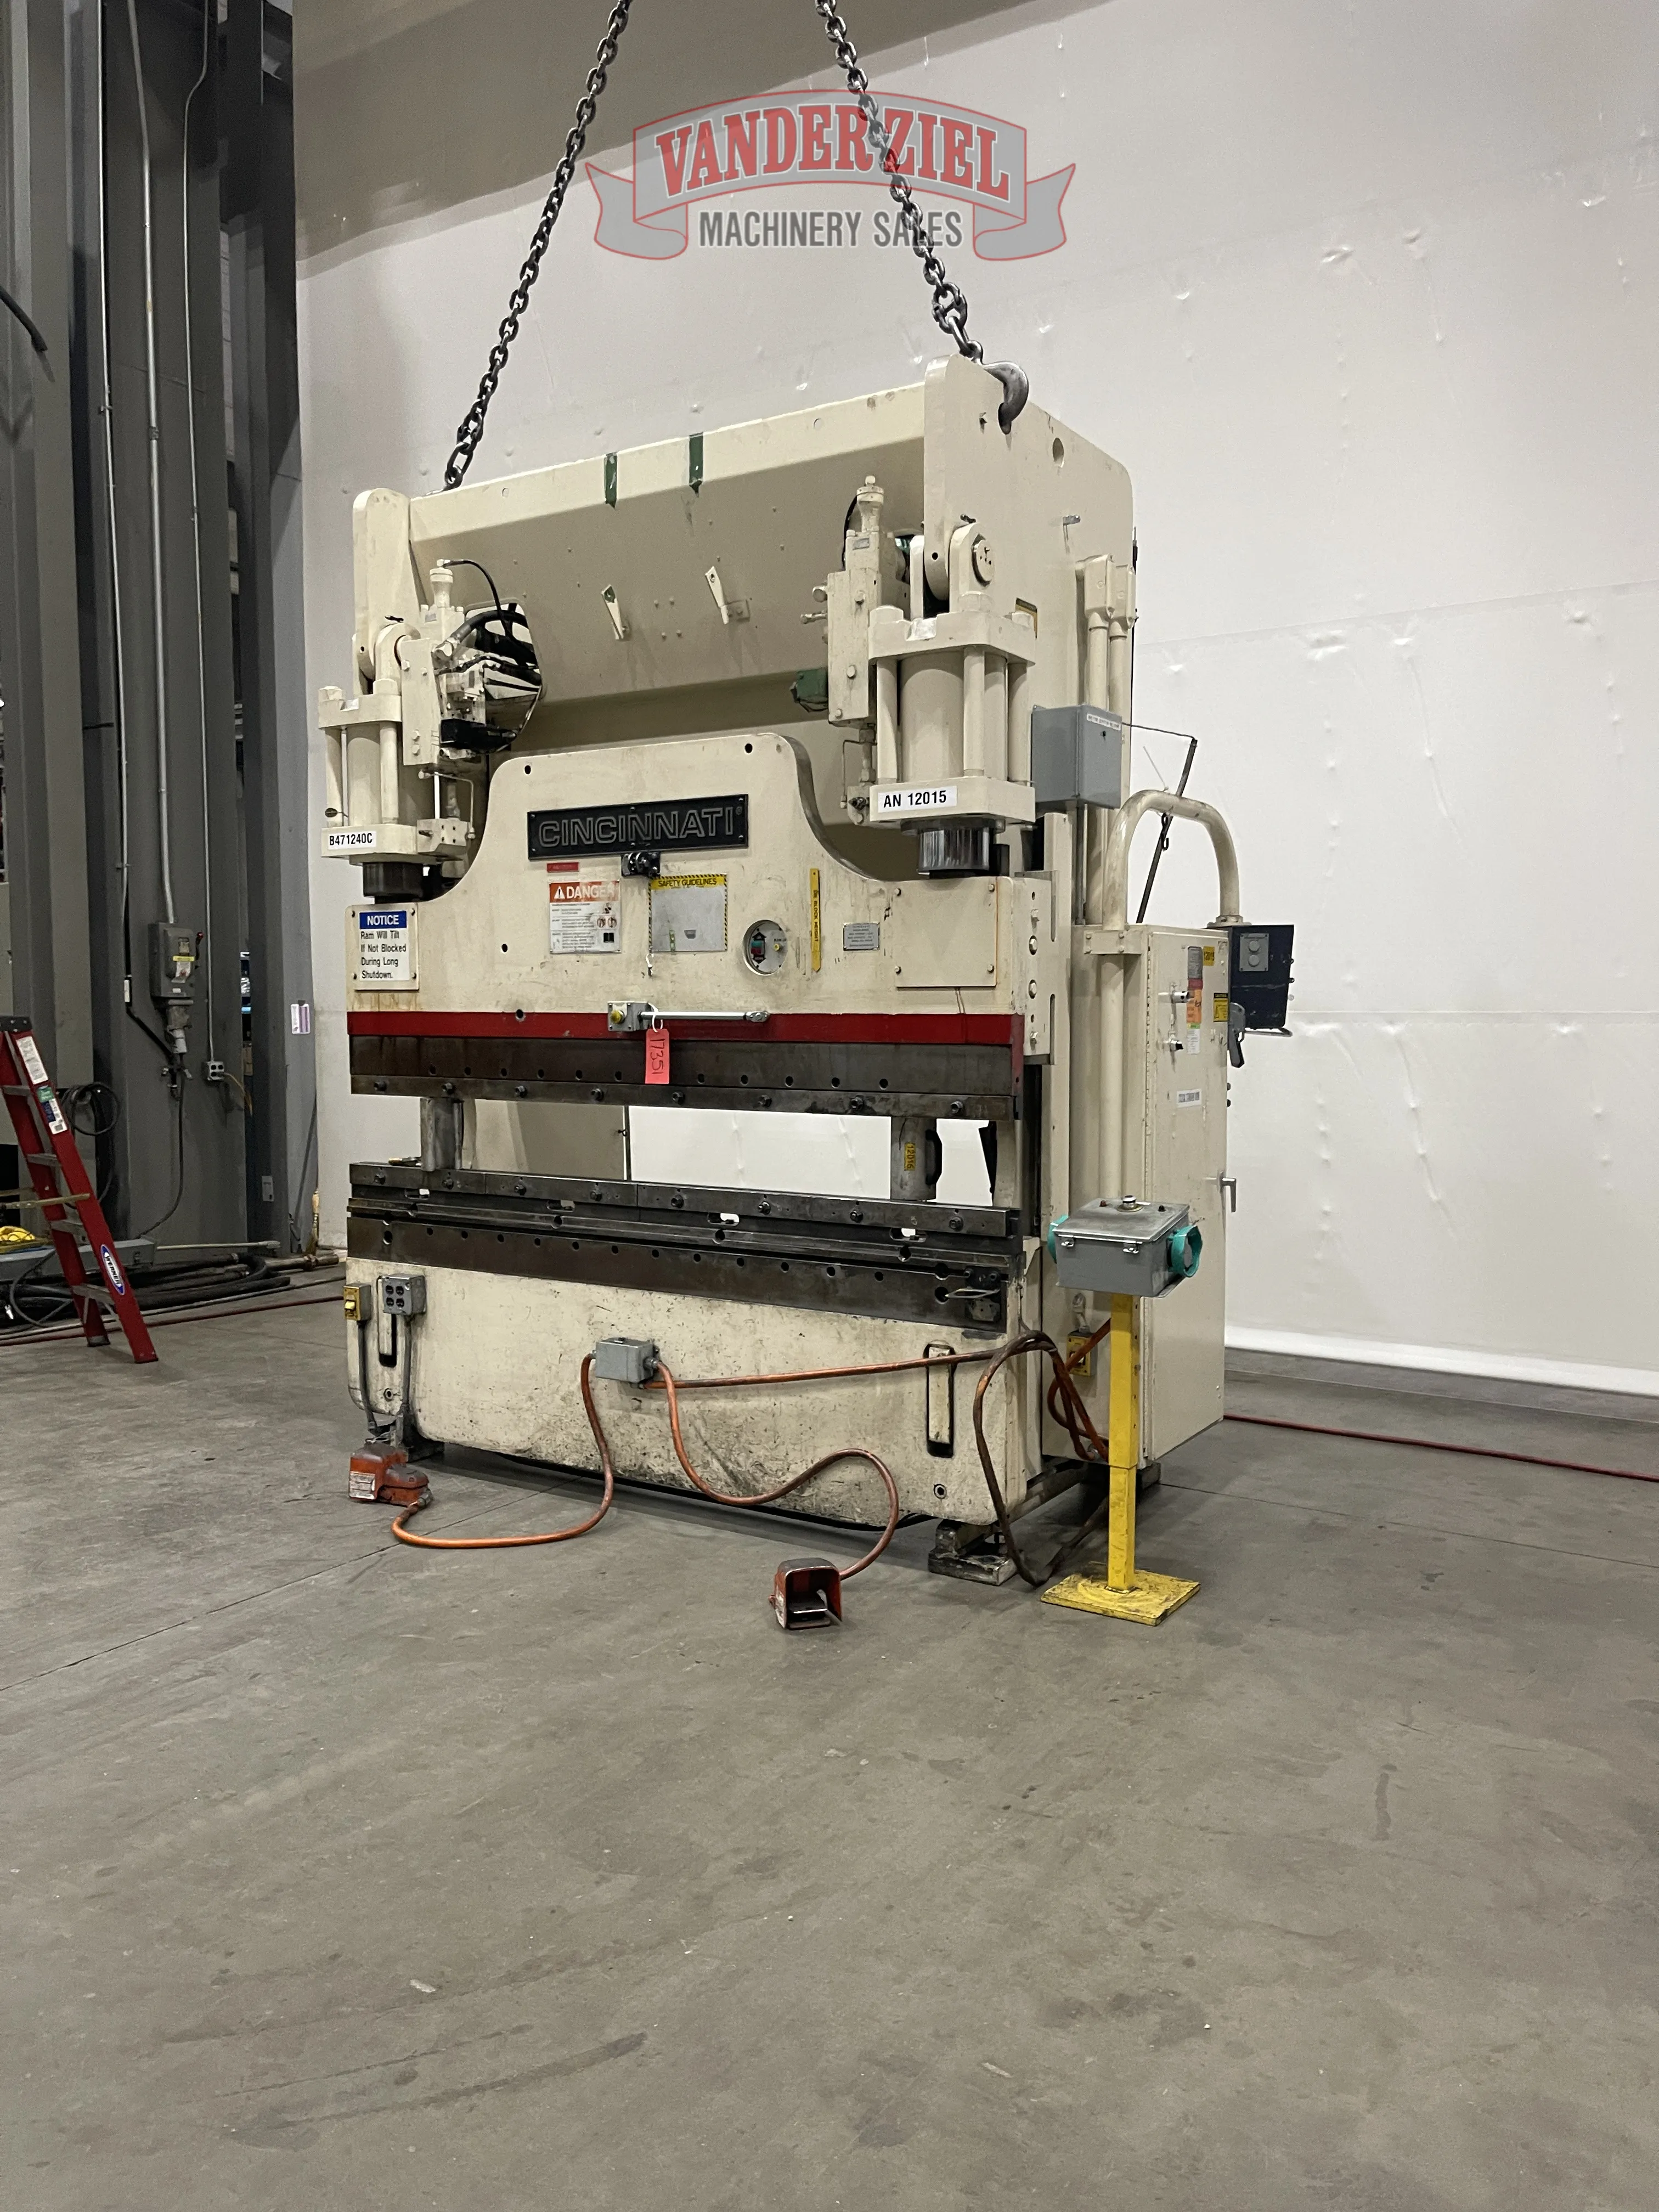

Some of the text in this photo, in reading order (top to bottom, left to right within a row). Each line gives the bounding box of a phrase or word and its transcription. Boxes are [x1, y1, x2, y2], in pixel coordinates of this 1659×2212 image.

[883, 790, 947, 808] AN 12015
[539, 806, 733, 848] CINCINNATI
[329, 832, 373, 846] B471240C
[566, 883, 615, 899] DANGER
[367, 915, 399, 926] NOTICE
[360, 931, 374, 939] Ram
[368, 944, 379, 952] Not
[381, 944, 407, 952] Blocked
[361, 957, 398, 967] During Long
[650, 1039, 665, 1074] 17351
